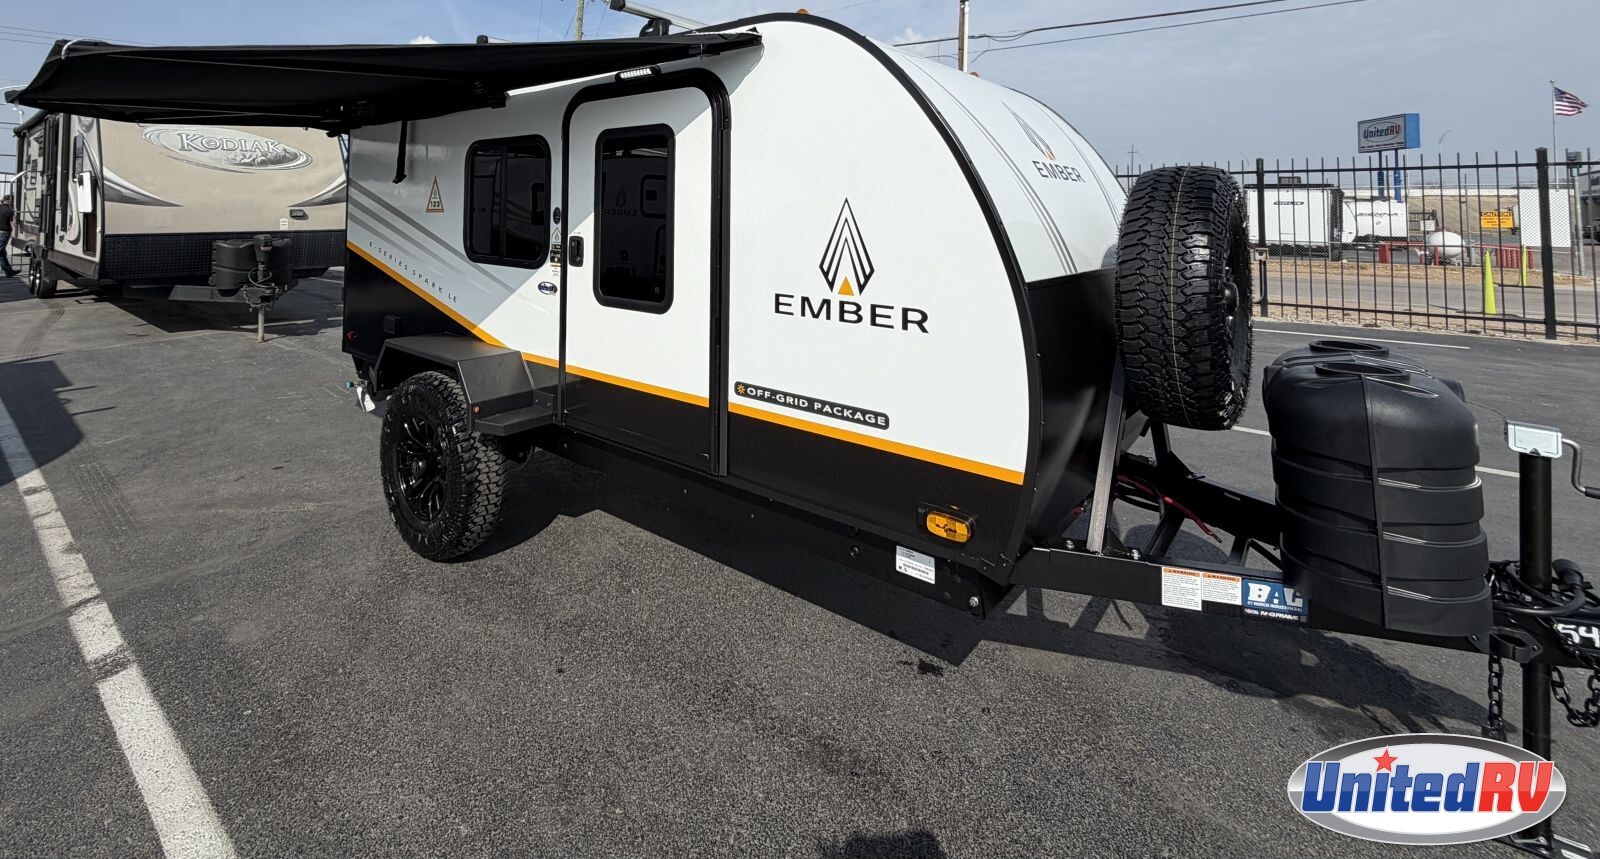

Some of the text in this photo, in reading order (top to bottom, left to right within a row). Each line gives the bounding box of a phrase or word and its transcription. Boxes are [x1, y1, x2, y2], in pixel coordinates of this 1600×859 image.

[176, 132, 281, 153] KODIAK
[1363, 124, 1401, 139] UnitedRV
[1031, 160, 1086, 183] EMBER
[430, 200, 441, 208] 123
[412, 269, 443, 293] SPARK
[448, 292, 457, 303] LE
[774, 292, 930, 334] EMBER
[746, 387, 887, 426] OFF-GRID PACKAGE
[1247, 582, 1304, 608] BAL
